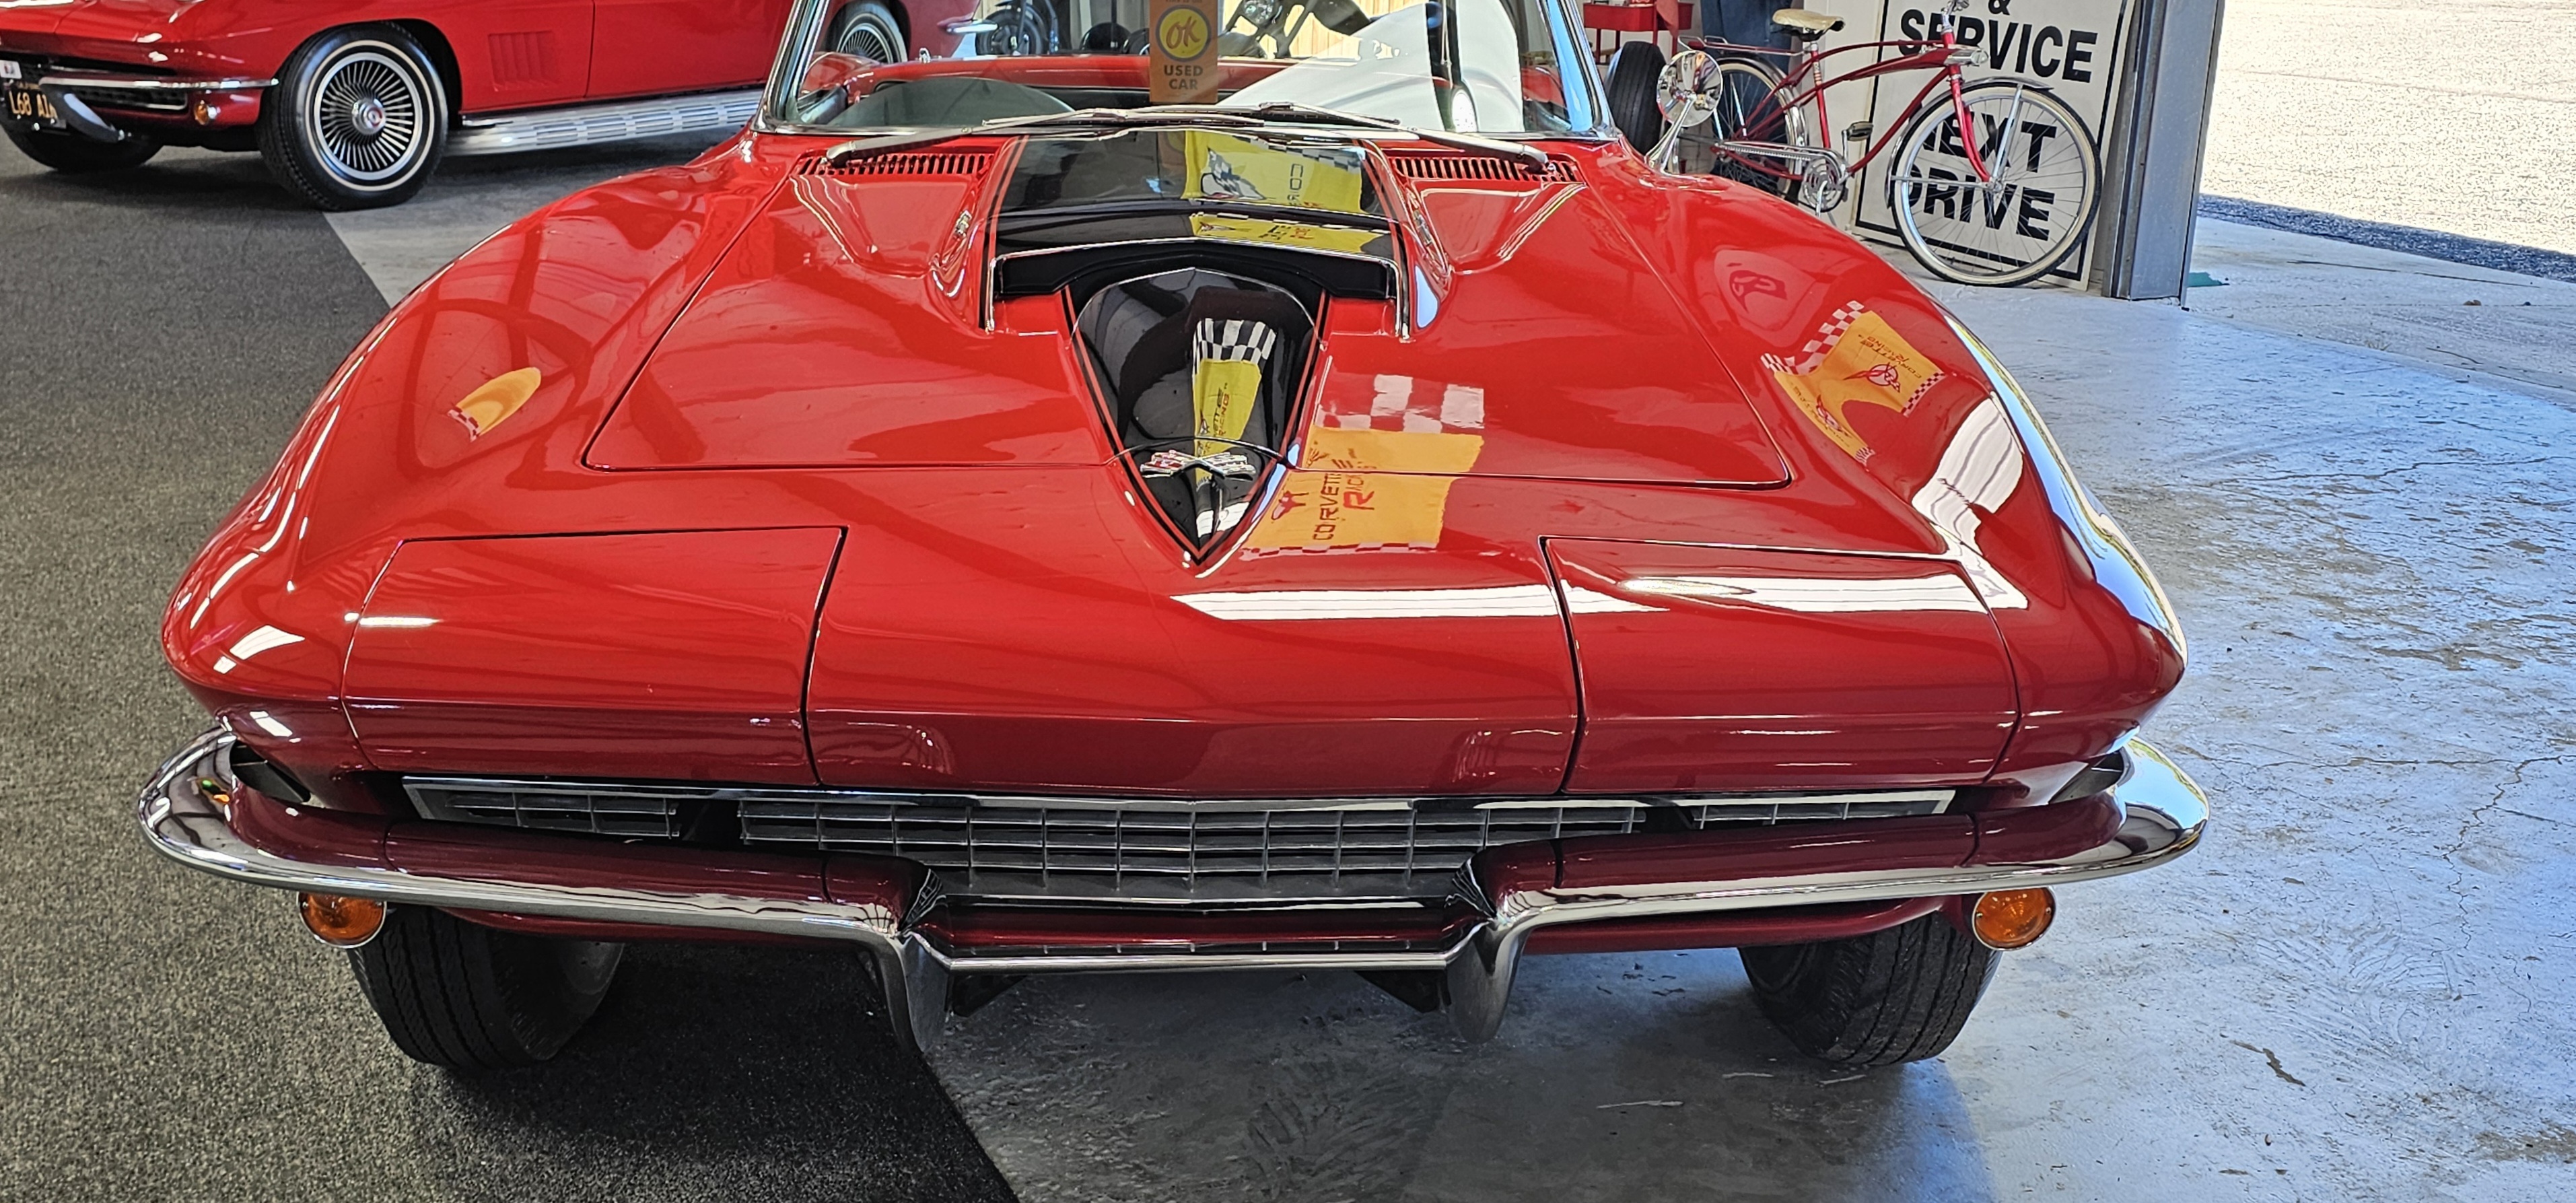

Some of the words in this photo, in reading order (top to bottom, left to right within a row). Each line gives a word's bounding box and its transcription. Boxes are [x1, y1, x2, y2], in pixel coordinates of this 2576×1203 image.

[1165, 16, 1201, 49] OK
[1163, 65, 1204, 77] USED
[1169, 78, 1199, 90] CAR
[8, 90, 32, 116] L68
